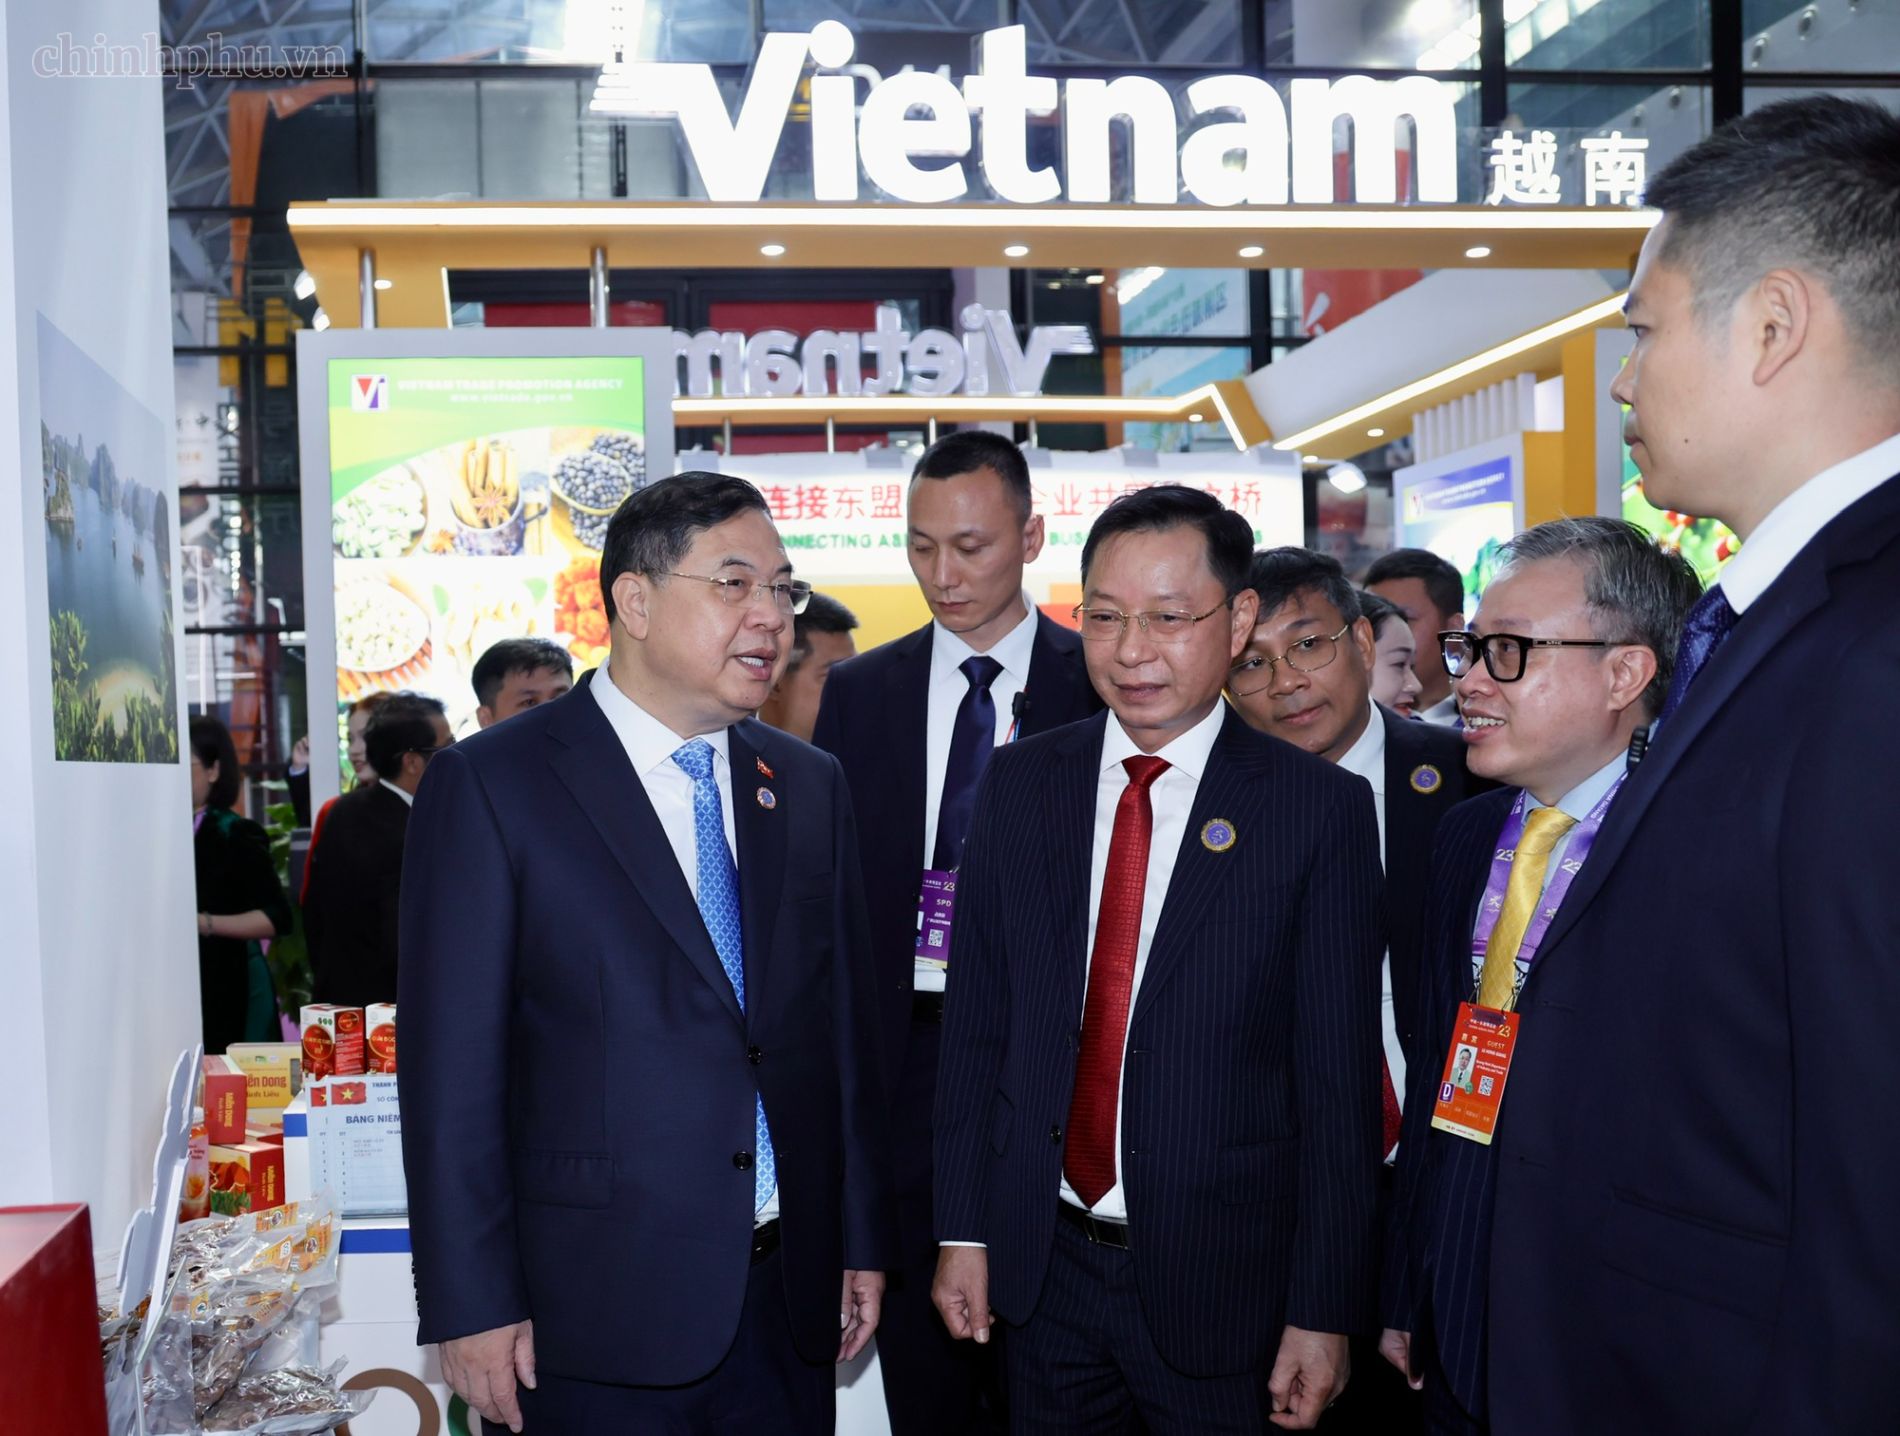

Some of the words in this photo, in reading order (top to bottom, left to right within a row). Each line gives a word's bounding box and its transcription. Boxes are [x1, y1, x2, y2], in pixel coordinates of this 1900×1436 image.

[589, 20, 1458, 206] Vietnam
[1489, 129, 1649, 207] 越南
[498, 379, 573, 390] PROMOTION
[575, 379, 624, 390] AGENCY
[1495, 849, 1515, 862] 23
[1497, 1024, 1511, 1038] 23
